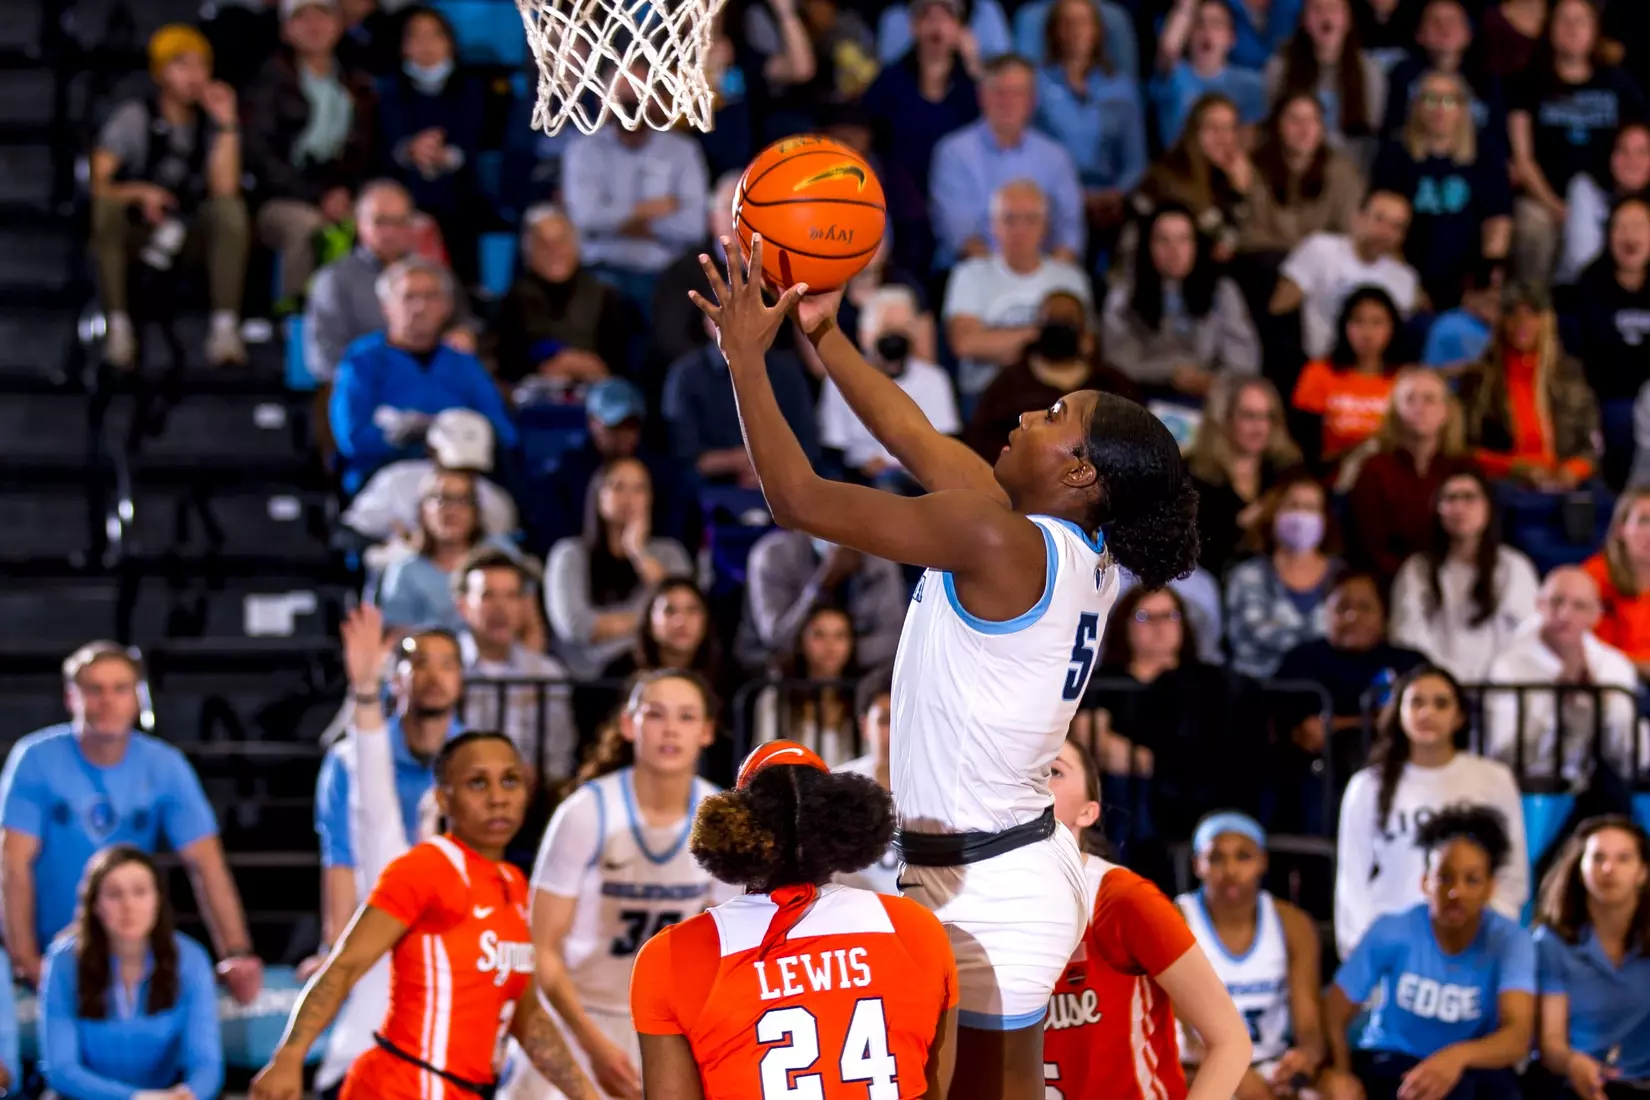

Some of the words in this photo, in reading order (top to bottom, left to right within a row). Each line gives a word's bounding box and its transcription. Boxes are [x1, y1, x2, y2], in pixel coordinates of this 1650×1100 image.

[1062, 611, 1099, 701] 5
[753, 947, 872, 1000] LEWIS
[1397, 972, 1482, 1023] EDGE
[755, 996, 901, 1100] 24
